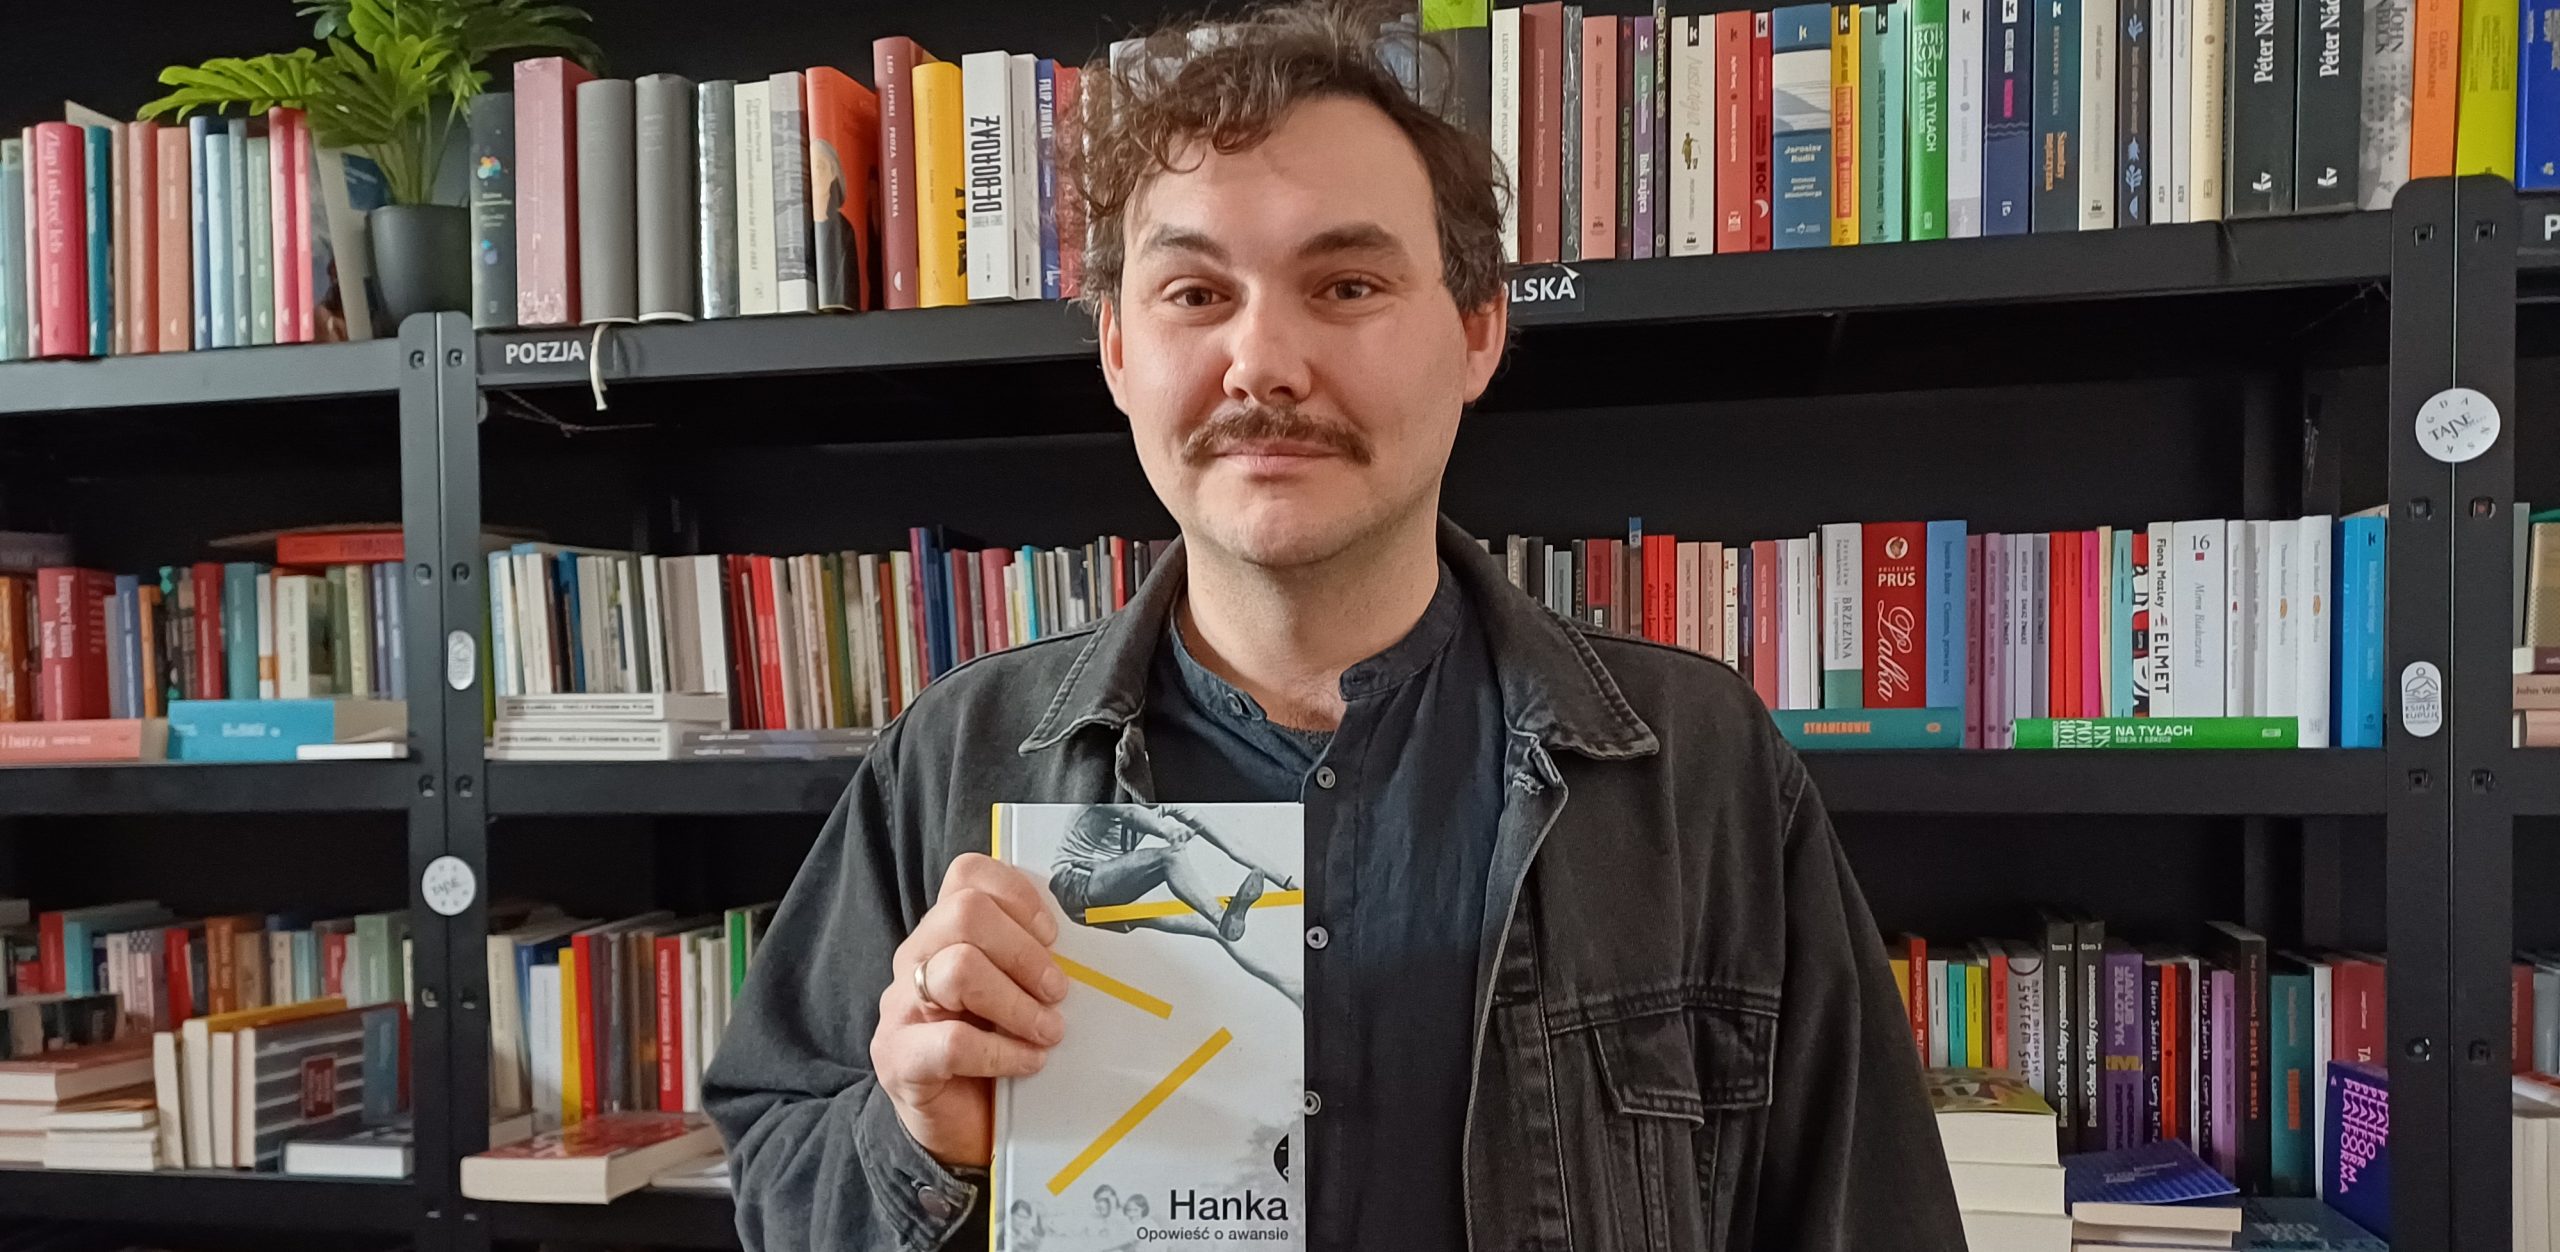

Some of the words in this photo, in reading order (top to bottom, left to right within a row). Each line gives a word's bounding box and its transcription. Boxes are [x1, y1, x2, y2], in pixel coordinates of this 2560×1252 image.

[2254, 0, 2274, 37] Nád
[886, 55, 894, 74] LEO
[1501, 33, 1509, 73] LEGENDY
[1656, 32, 1665, 84] Tokarczuk
[2254, 38, 2273, 83] Péter
[2319, 32, 2340, 78] Péter
[888, 84, 896, 117] LIPSKI
[1038, 78, 1052, 102] FILIP
[1681, 56, 1706, 128] Nostalgia
[1926, 81, 1937, 101] NA
[1039, 103, 1053, 140] ZAWADA
[1926, 103, 1938, 152] TYŁACH
[889, 127, 897, 159] PROZA
[1784, 144, 1823, 155] Jaroslav
[1639, 153, 1650, 176] Rok
[1756, 161, 1767, 194] NOC
[890, 168, 898, 218] WYBRANA
[1637, 177, 1650, 214] zająca
[1511, 276, 1576, 303] LSKA
[505, 340, 585, 365] POEZJA
[2156, 538, 2167, 568] Fiona
[2192, 534, 2210, 551] 16
[1878, 573, 1916, 587] PRUS
[1728, 625, 1736, 658] TROCHU
[1842, 597, 1853, 660] BRZEZINA
[1877, 599, 1916, 703] Lalka
[2154, 633, 2169, 694] ELMET
[2115, 725, 2136, 737] NA
[2138, 724, 2193, 737] TYŁACH
[2017, 983, 2032, 1044] SYSTEM
[2124, 966, 2135, 1025] JAKUB
[2340, 1077, 2352, 1194] PLATFORMA
[2348, 1080, 2361, 1183] PLATFORM
[2356, 1083, 2369, 1169] PLATFOR
[1170, 1189, 1289, 1221] Hanka
[1136, 1226, 1210, 1244] Opowieść
[1215, 1230, 1225, 1242] o
[1228, 1226, 1289, 1242] awansie
